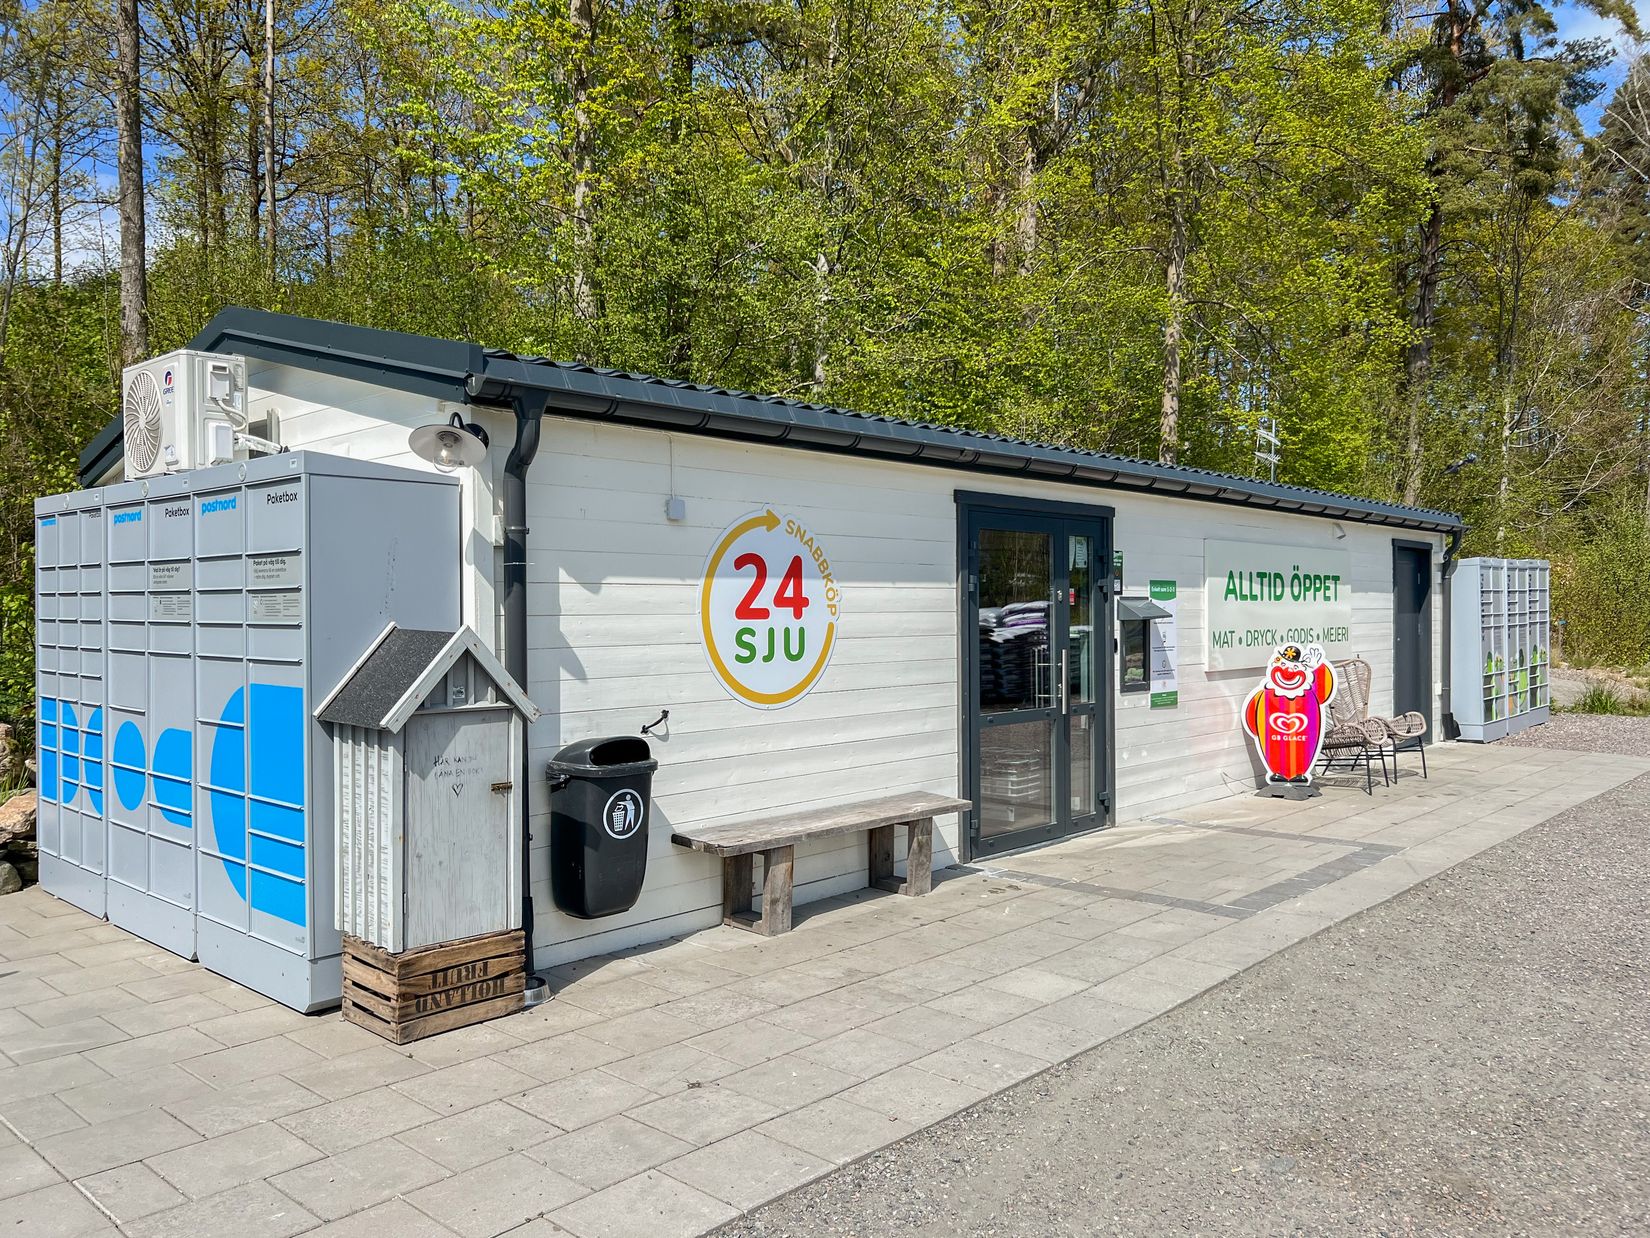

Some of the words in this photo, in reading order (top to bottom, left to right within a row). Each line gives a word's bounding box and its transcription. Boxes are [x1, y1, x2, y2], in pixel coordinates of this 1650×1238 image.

[202, 496, 236, 516] postnord
[266, 491, 298, 504] Paketbox
[114, 510, 142, 525] postnord
[165, 508, 190, 518] Paketbox
[784, 520, 840, 616] SNABBKÖP
[734, 552, 810, 620] 24
[1224, 570, 1284, 602] ALLTID
[1290, 565, 1340, 602] ÖPPET
[734, 626, 806, 664] SJU
[1212, 630, 1235, 648] MAT
[1246, 629, 1277, 647] DRYCK
[1286, 627, 1314, 644] GODIS
[1323, 627, 1348, 642] MEJERI
[428, 961, 488, 990] FRUIT
[415, 978, 505, 1013] HOLLAND
